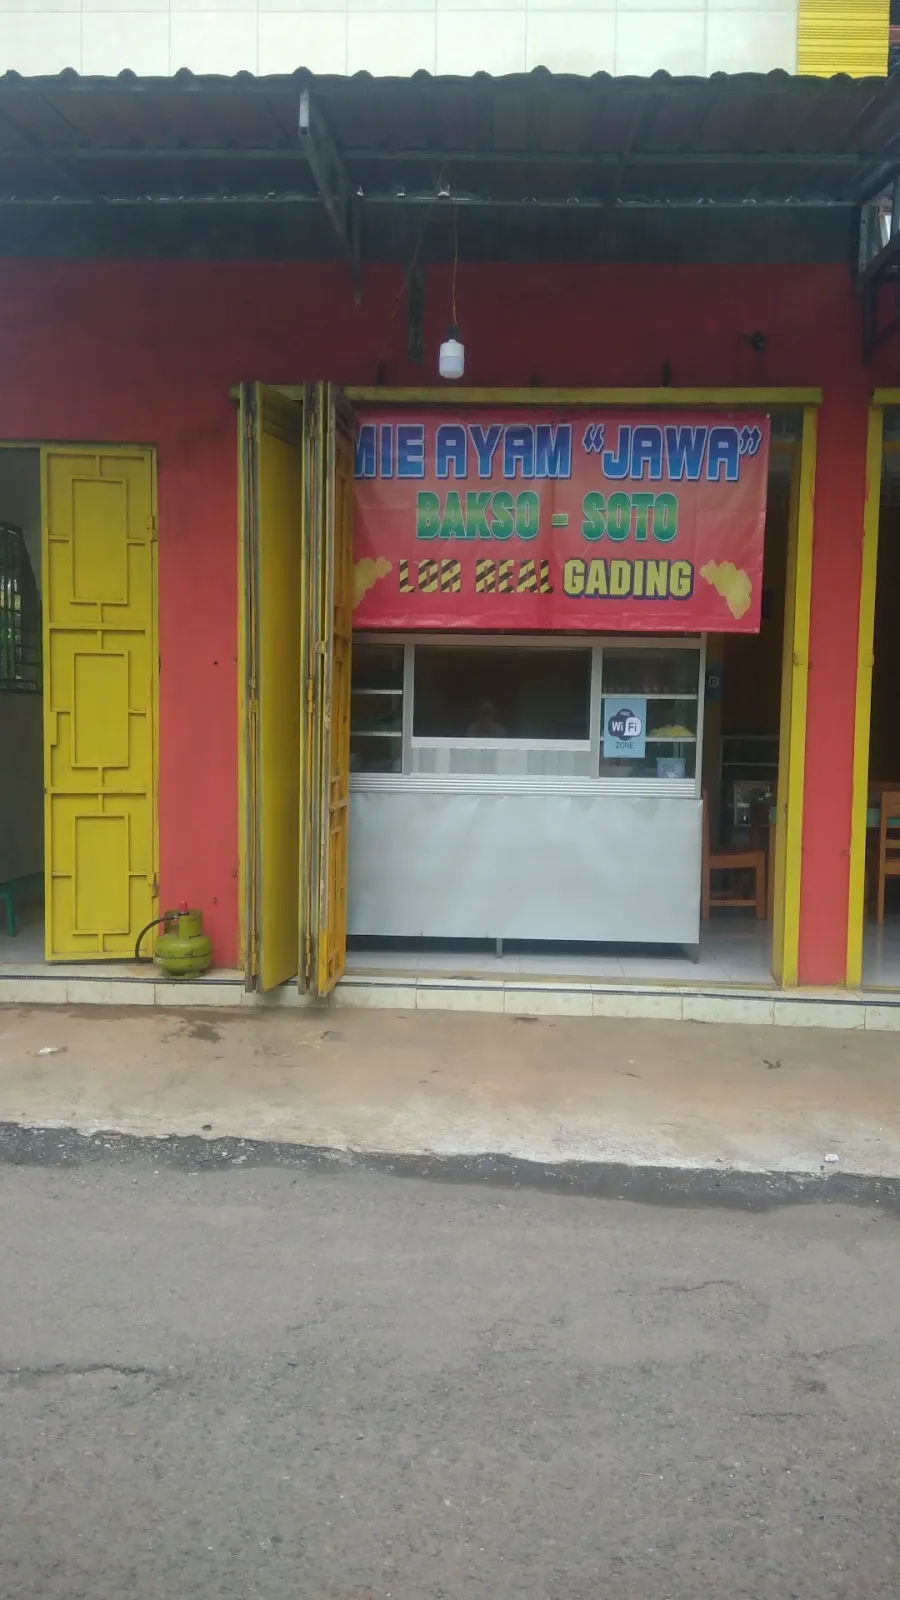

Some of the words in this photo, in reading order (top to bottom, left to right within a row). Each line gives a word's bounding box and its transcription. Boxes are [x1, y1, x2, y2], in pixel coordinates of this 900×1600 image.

[354, 424, 425, 478] MIE
[435, 424, 572, 479] AYAM
[582, 424, 762, 482] “JAWA”
[416, 490, 540, 540] BAKSO
[581, 491, 679, 542] SOTO
[399, 559, 461, 593] LOR
[475, 559, 554, 593] REAL
[563, 558, 694, 600] GADING
[615, 741, 634, 750] ZONE
